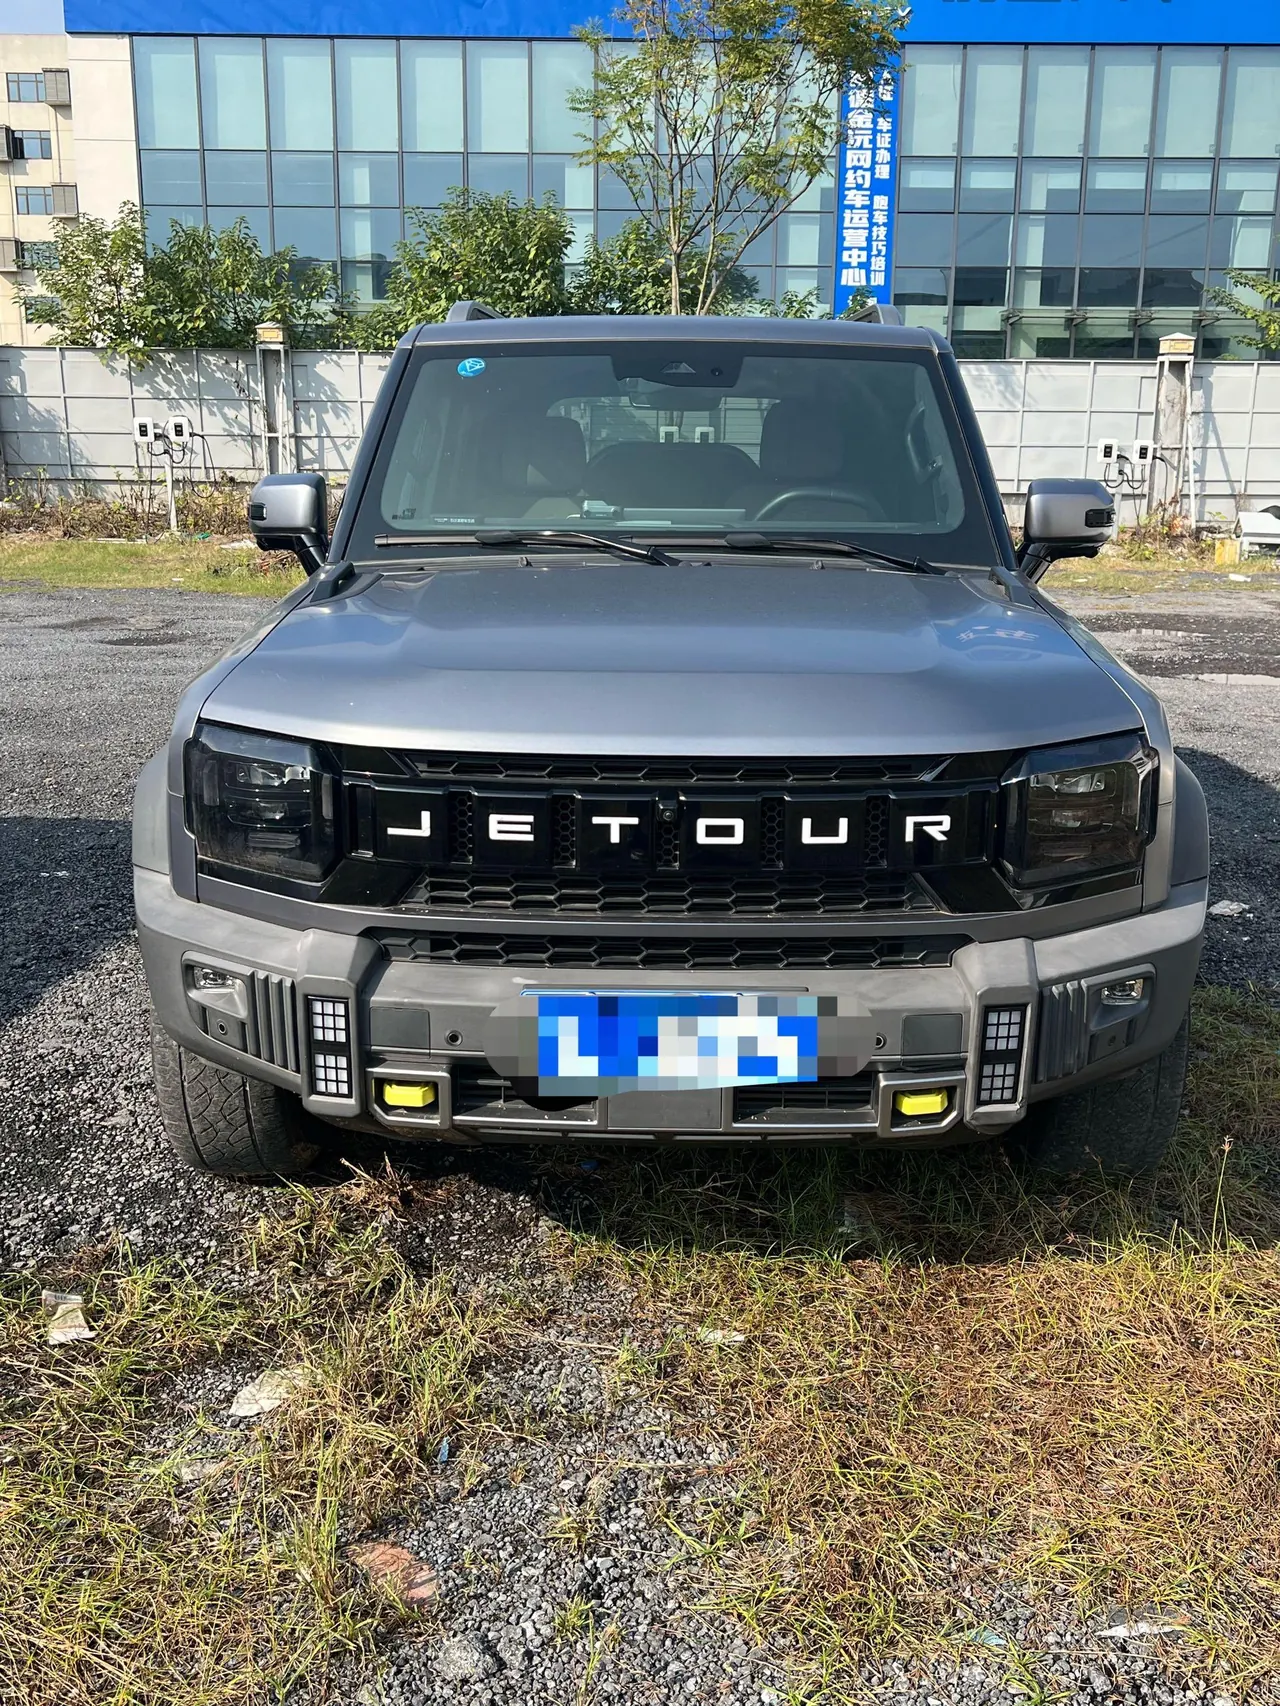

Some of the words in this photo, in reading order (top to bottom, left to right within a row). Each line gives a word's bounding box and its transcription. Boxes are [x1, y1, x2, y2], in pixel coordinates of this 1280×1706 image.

[874, 117, 893, 179] 车证办理
[870, 195, 889, 286] 跑车技巧培训
[387, 810, 952, 845] JETOUR
